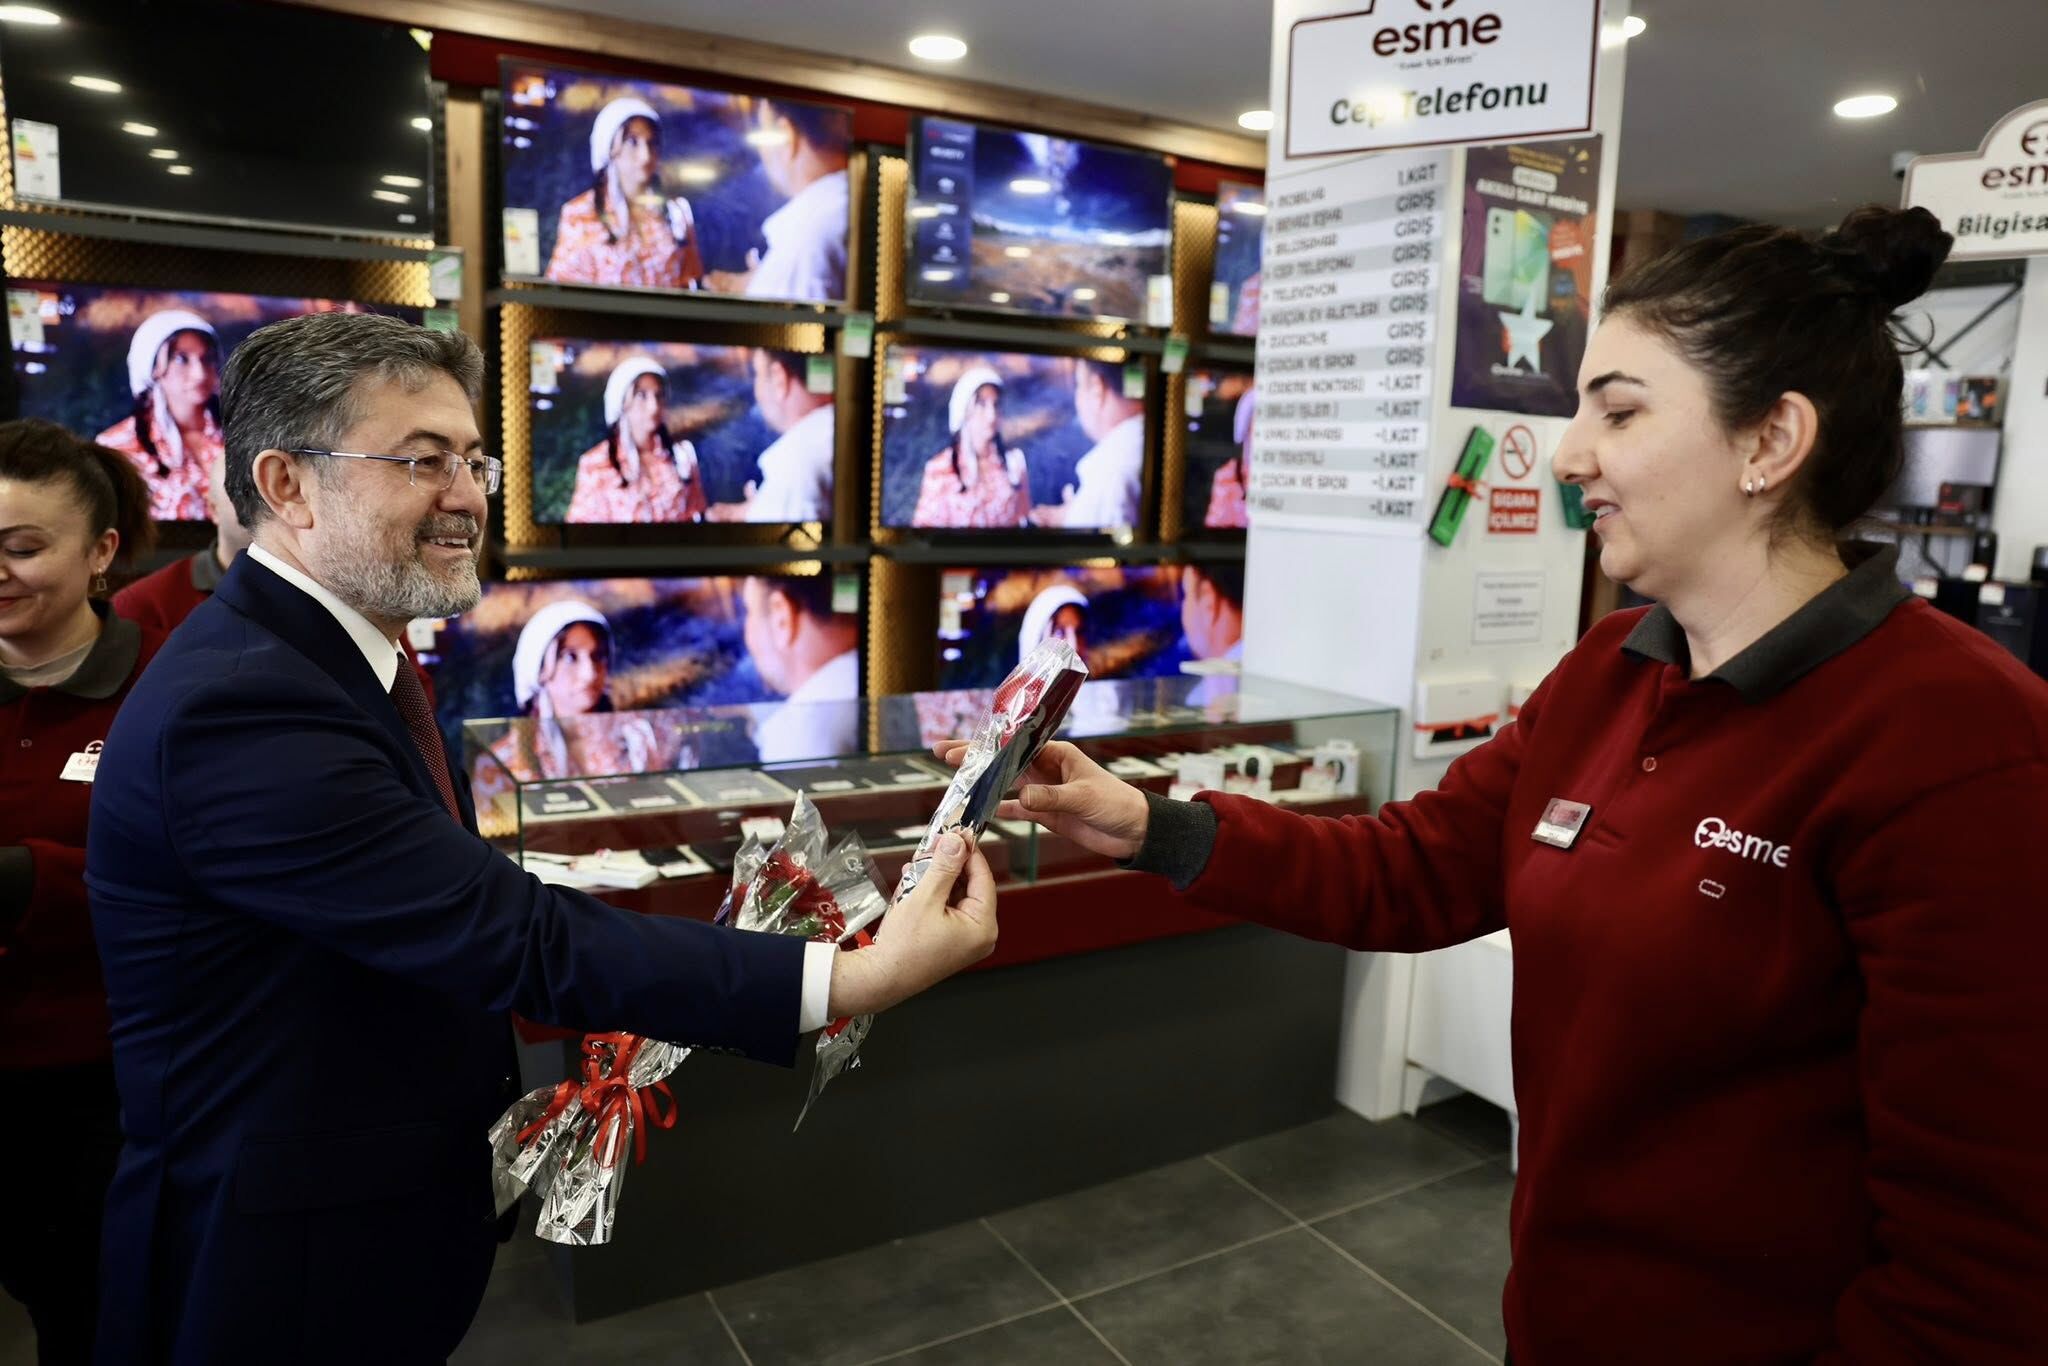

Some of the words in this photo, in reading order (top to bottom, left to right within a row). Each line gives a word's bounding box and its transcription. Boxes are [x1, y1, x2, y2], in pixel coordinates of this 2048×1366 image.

[1373, 13, 1502, 57] esme
[1400, 82, 1548, 119] Telefonu
[1715, 826, 1791, 868] esme
